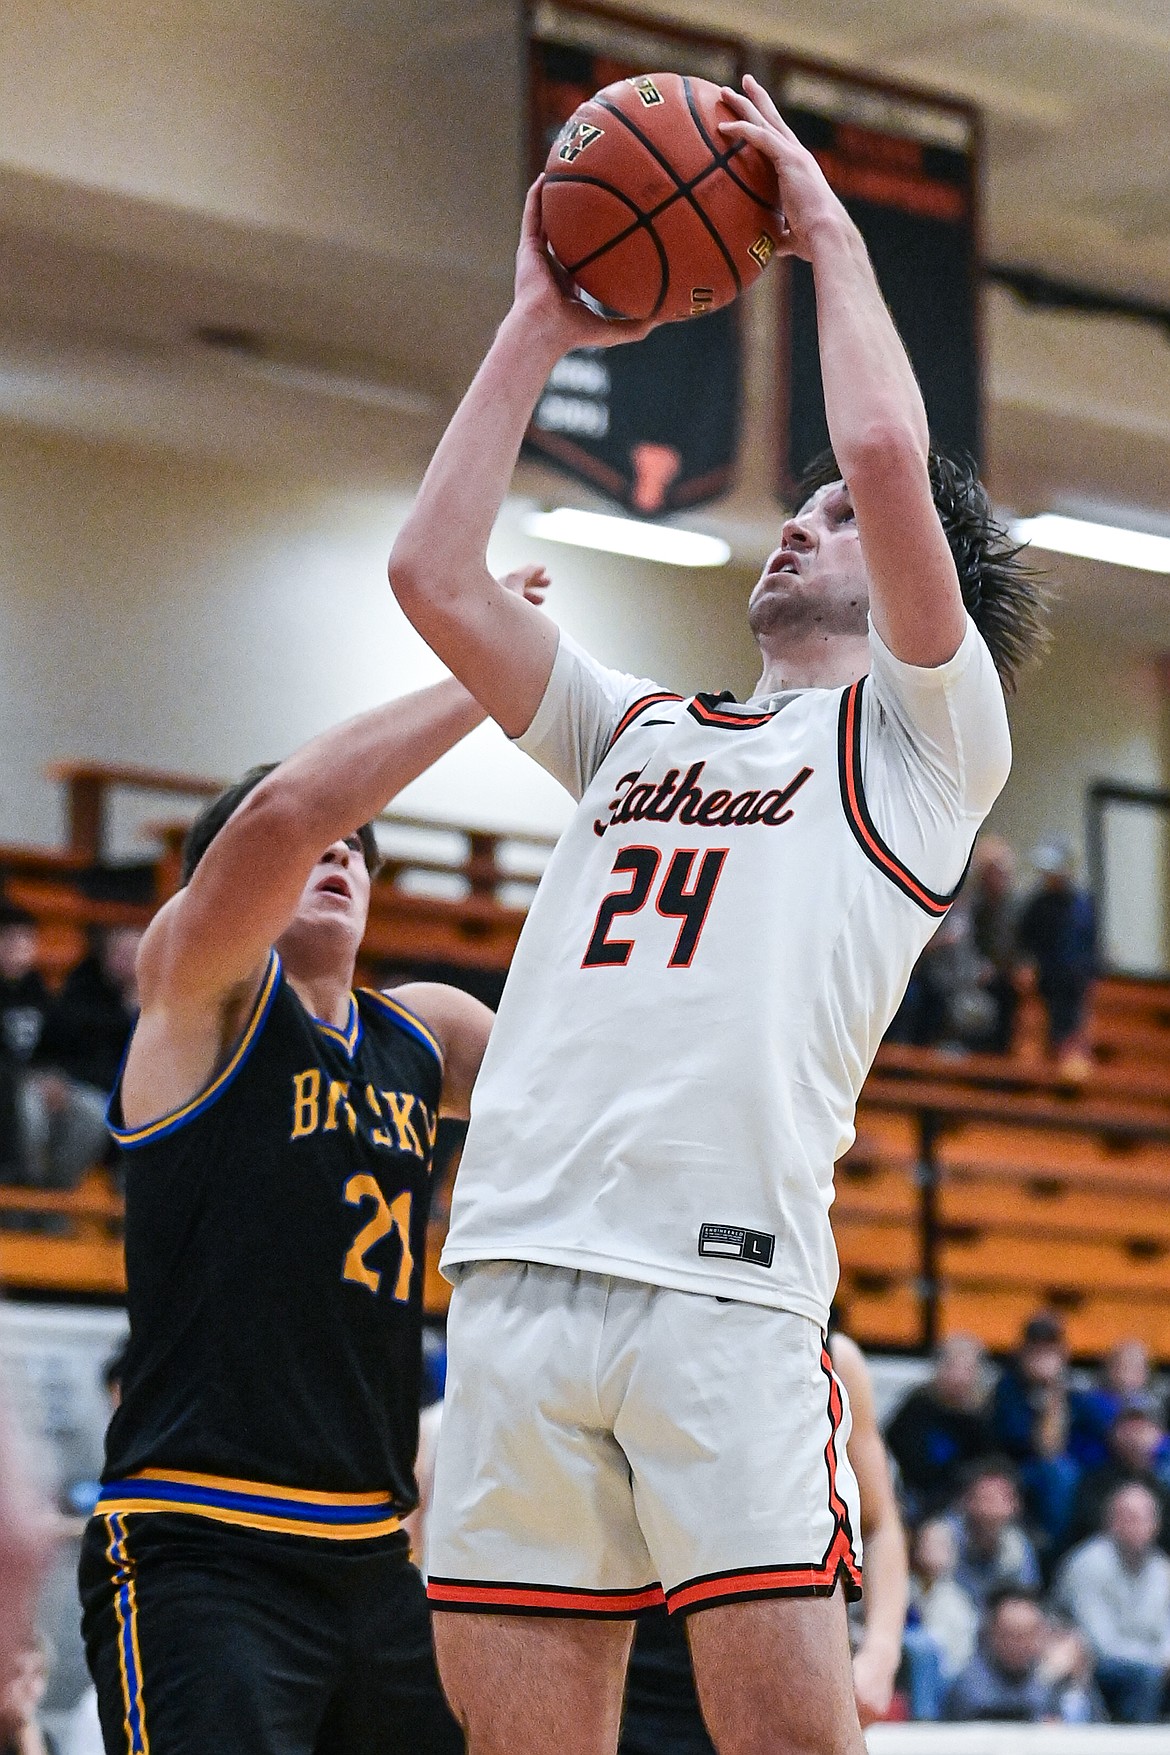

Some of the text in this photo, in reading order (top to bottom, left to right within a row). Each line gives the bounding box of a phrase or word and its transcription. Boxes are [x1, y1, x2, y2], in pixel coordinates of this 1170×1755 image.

[580, 845, 730, 969] 24
[341, 1171, 414, 1303] 21
[752, 1240, 762, 1255] L
